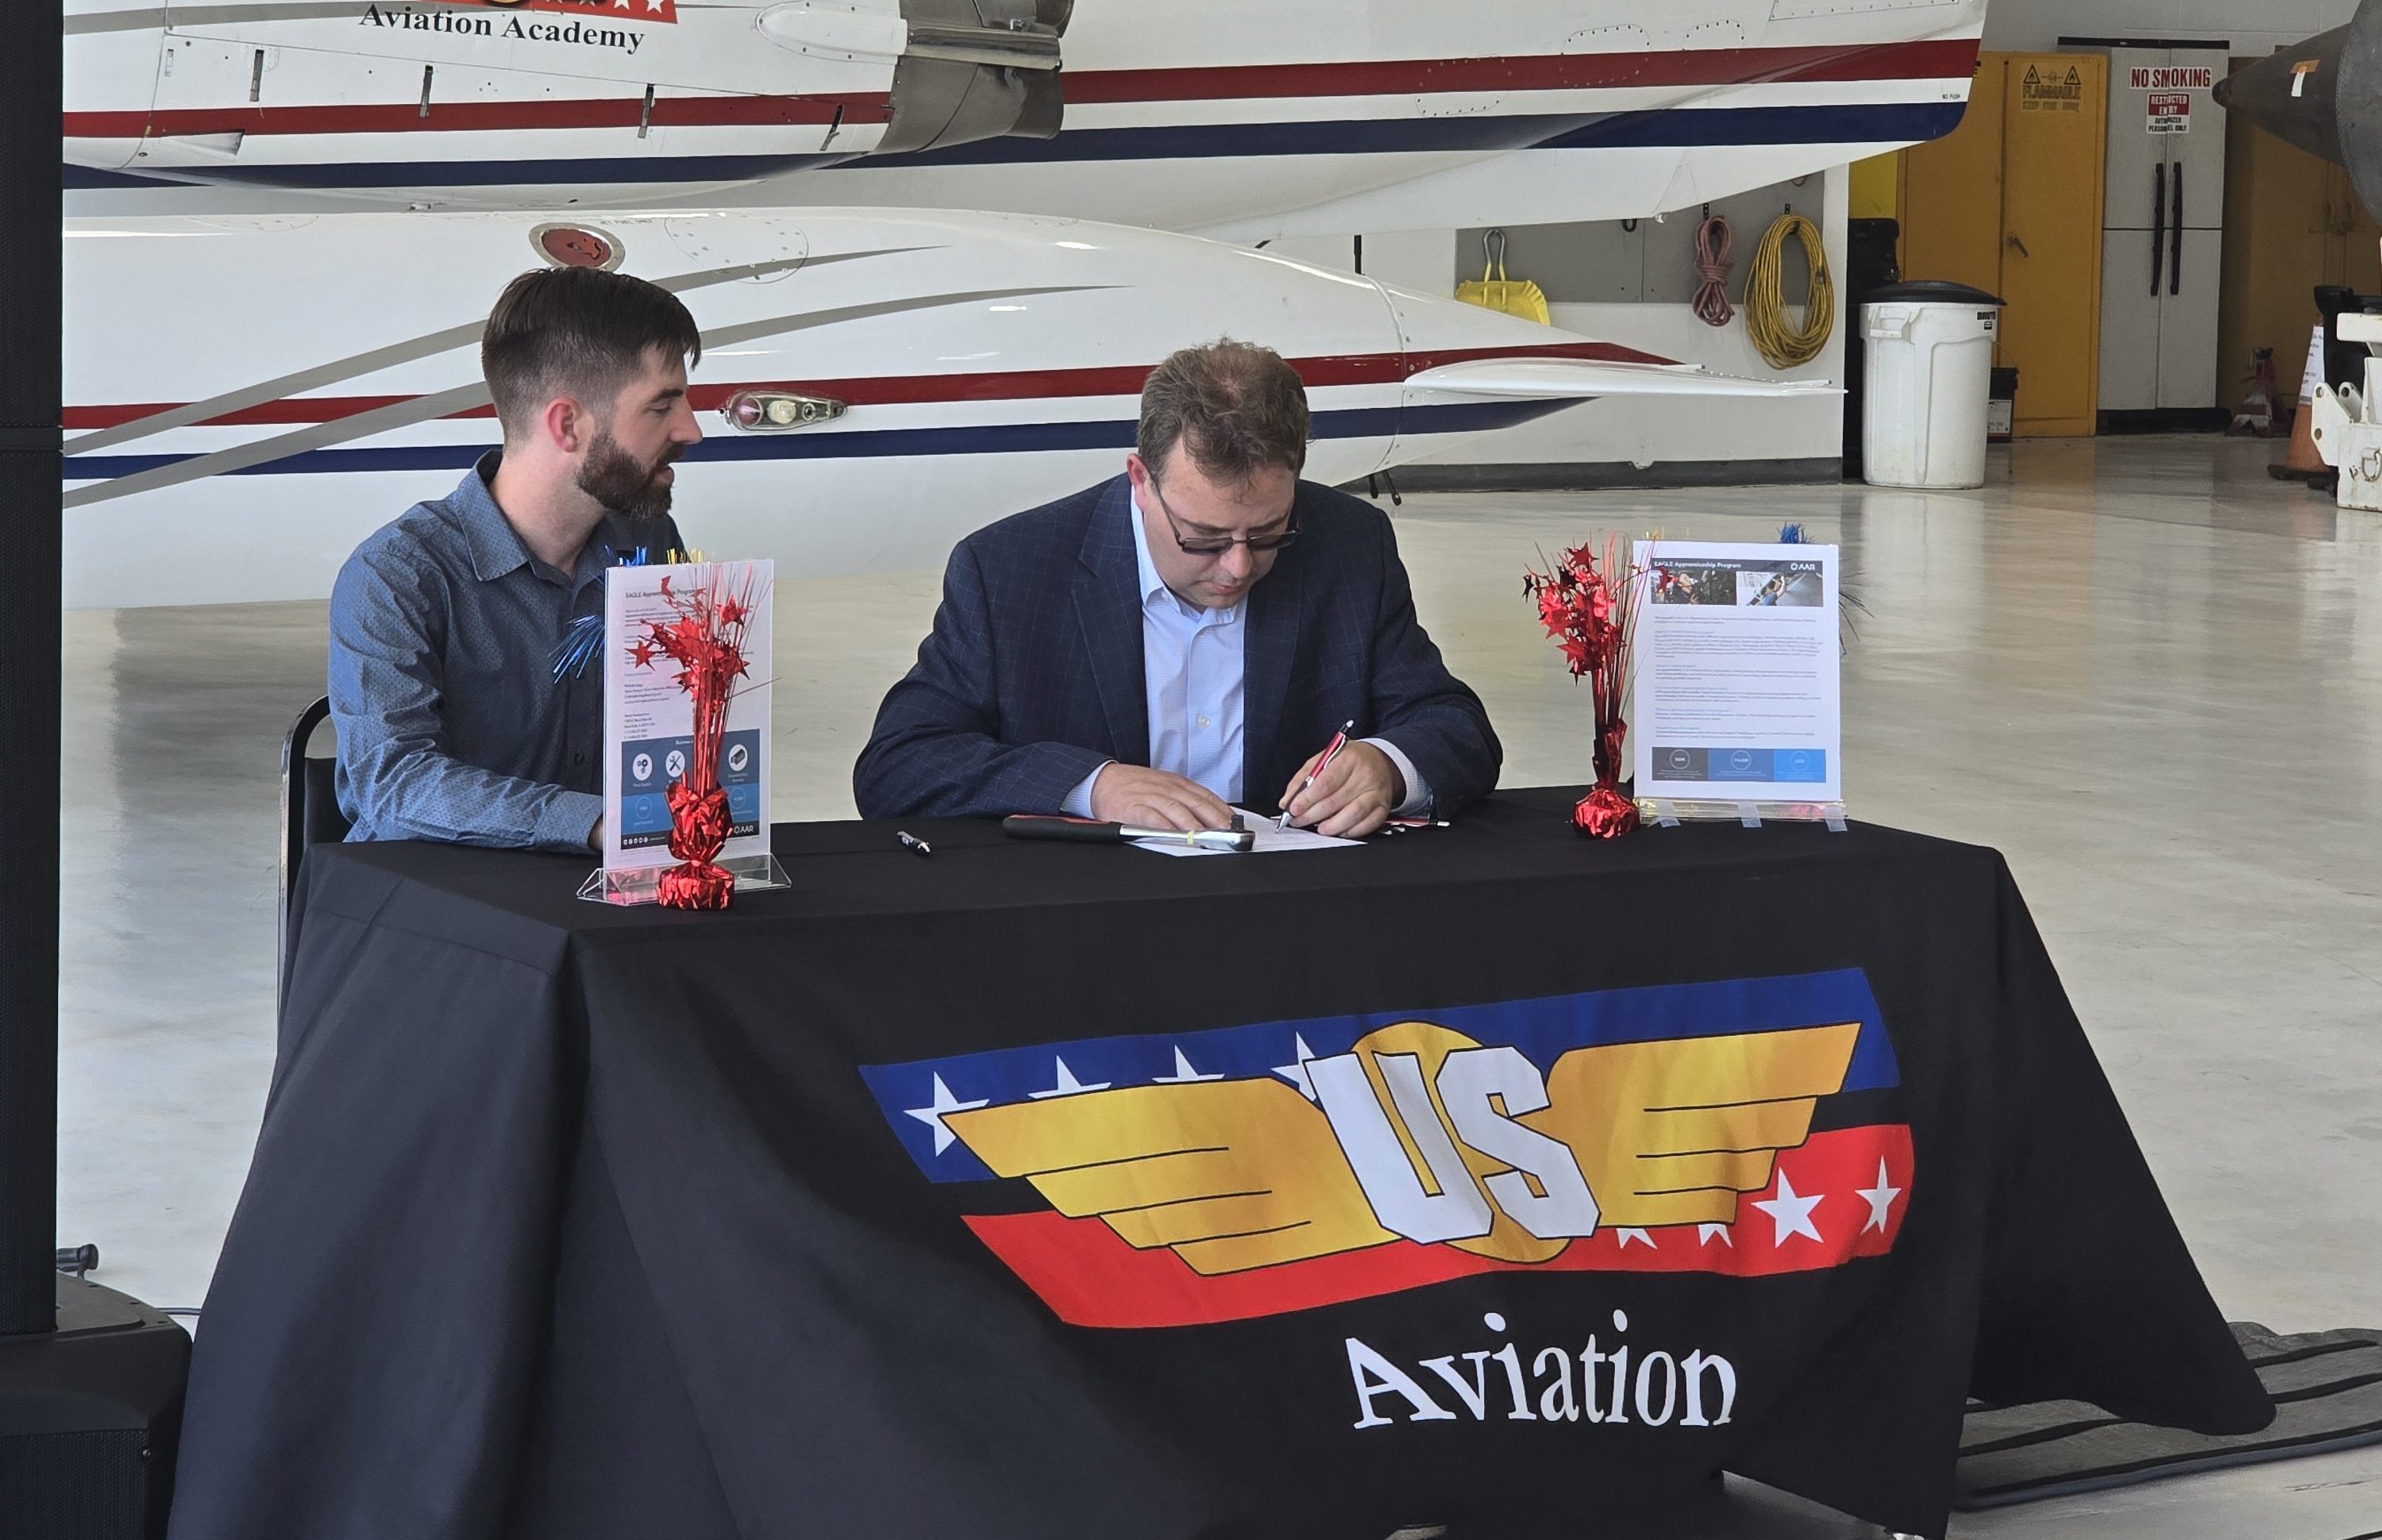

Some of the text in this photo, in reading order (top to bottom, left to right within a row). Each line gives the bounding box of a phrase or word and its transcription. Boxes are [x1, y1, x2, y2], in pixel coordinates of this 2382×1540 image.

[359, 2, 645, 55] Aviation Academy
[2131, 68, 2210, 87] NO SMOKING
[2022, 84, 2082, 100] FLAMMABLE
[2159, 106, 2177, 114] ENRY
[1654, 560, 1674, 568] EAGLE
[1675, 560, 1717, 569] Apprenticeship
[1717, 561, 1741, 570] Program
[741, 825, 754, 834] AAR
[1302, 1046, 1601, 1245] US
[1344, 1308, 1737, 1430] Aviation
